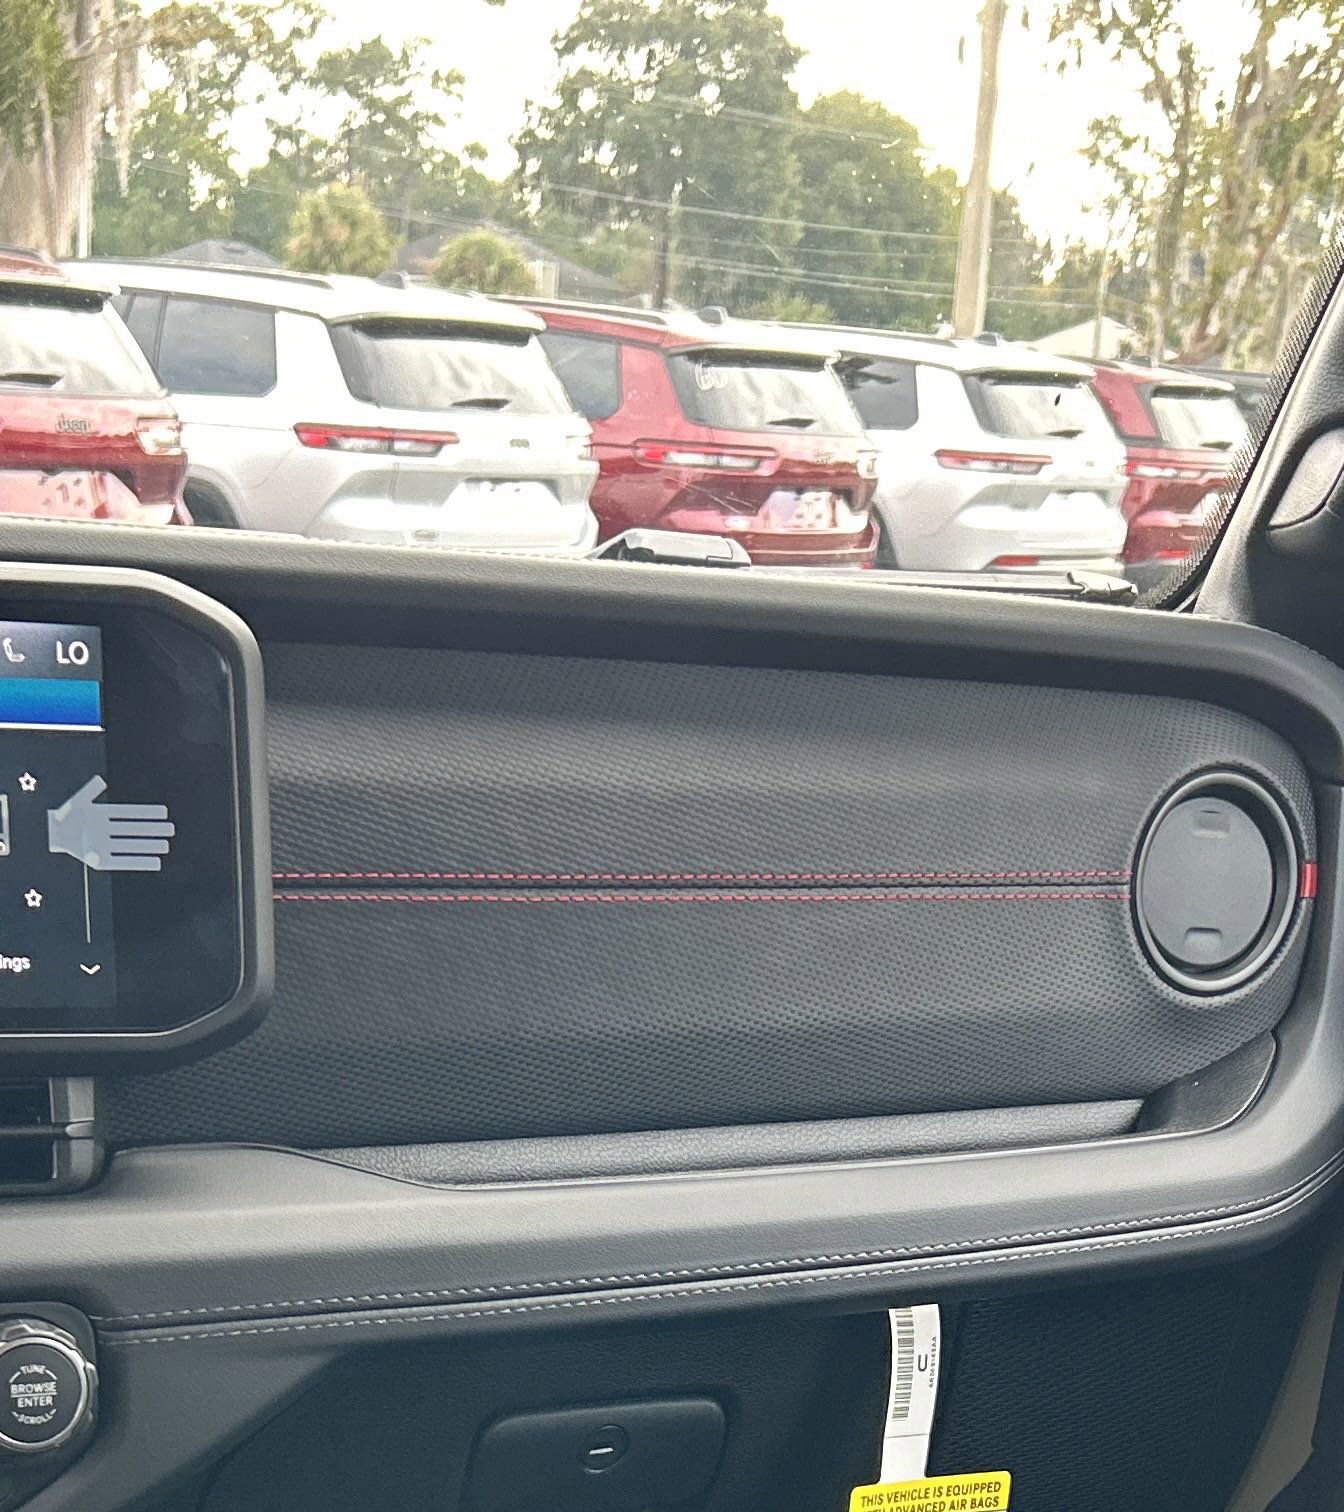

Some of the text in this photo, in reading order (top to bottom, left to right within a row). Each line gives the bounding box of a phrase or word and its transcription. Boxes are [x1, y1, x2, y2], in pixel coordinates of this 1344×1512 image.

[55, 639, 89, 666] LO
[19, 1364, 47, 1375] TUNE
[9, 1380, 58, 1395] BROWSE
[16, 1395, 55, 1409] ENTER
[16, 1410, 56, 1426] SCROLL
[860, 1481, 1002, 1509] THIS VEHICLE IS EQUIPPED
[948, 1499, 968, 1512] AIR
[969, 1495, 1000, 1510] BAGS
